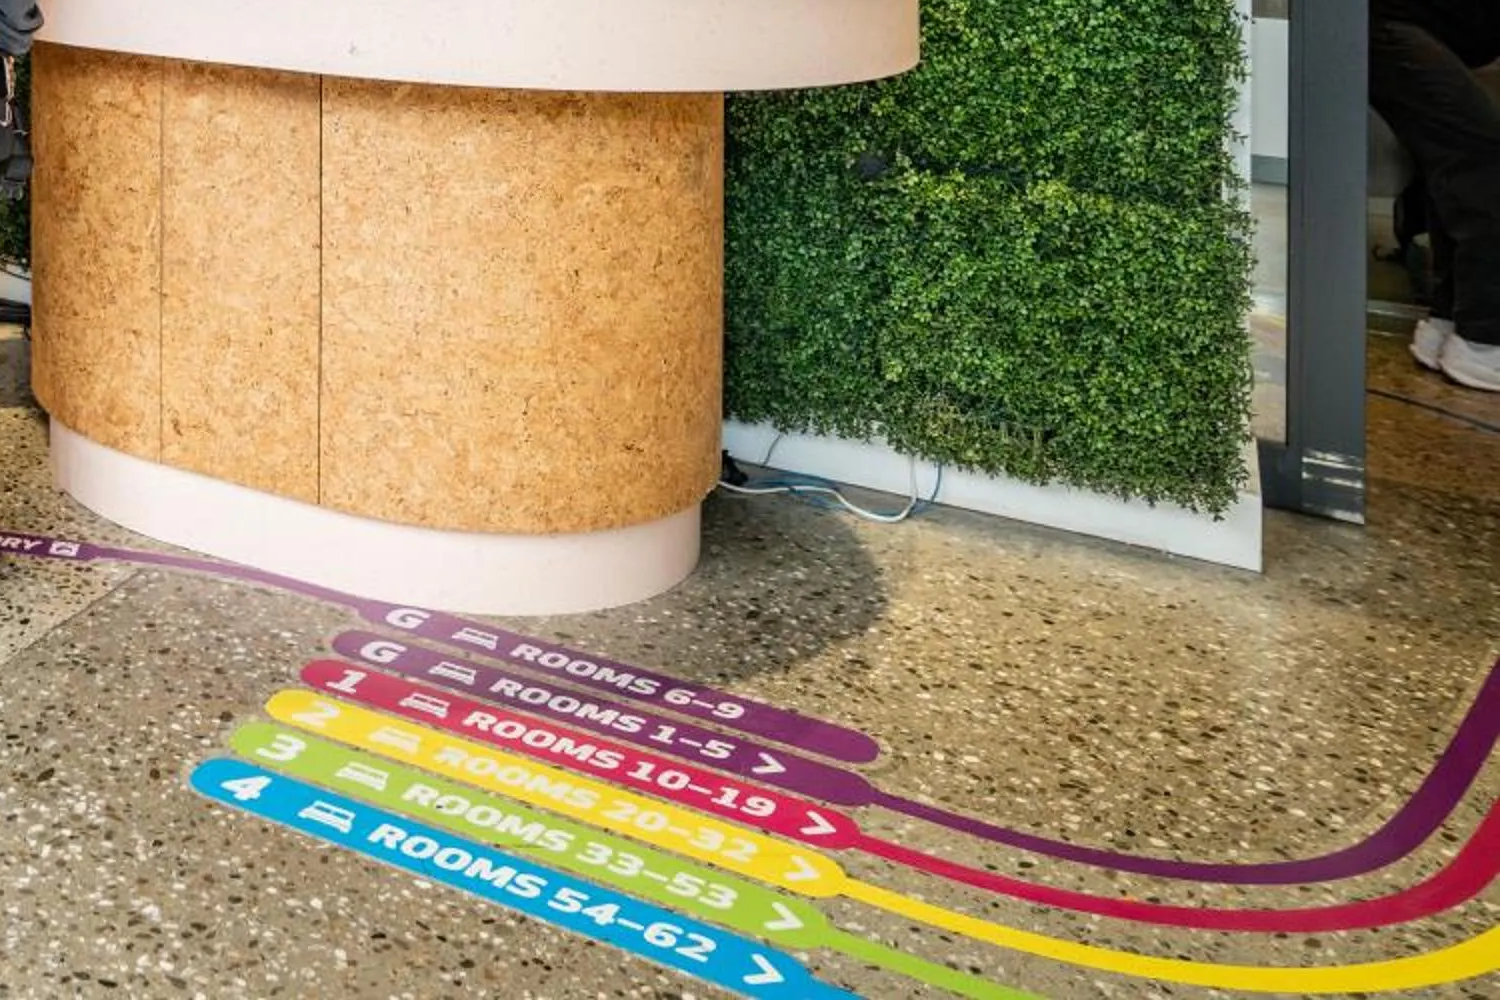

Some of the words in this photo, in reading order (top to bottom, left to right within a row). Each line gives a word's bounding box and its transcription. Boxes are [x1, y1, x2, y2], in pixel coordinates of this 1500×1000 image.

[360, 640, 407, 664] G
[489, 677, 647, 734] ROOMS
[649, 724, 736, 760] 1-5
[385, 608, 431, 630] G
[509, 643, 661, 696] ROOMS
[664, 688, 745, 720] 6-9
[291, 700, 341, 728] 2
[434, 746, 601, 810] ROOMS
[602, 799, 759, 864] 20-32
[326, 668, 368, 695] 1
[462, 710, 626, 770] ROOMS
[627, 760, 777, 818] 10-19
[220, 775, 272, 800] 4
[367, 823, 548, 900] ROOMS
[547, 887, 717, 963] 54-62
[256, 733, 308, 762] 3
[402, 783, 575, 853] ROOMS
[576, 840, 739, 911] 33-53
